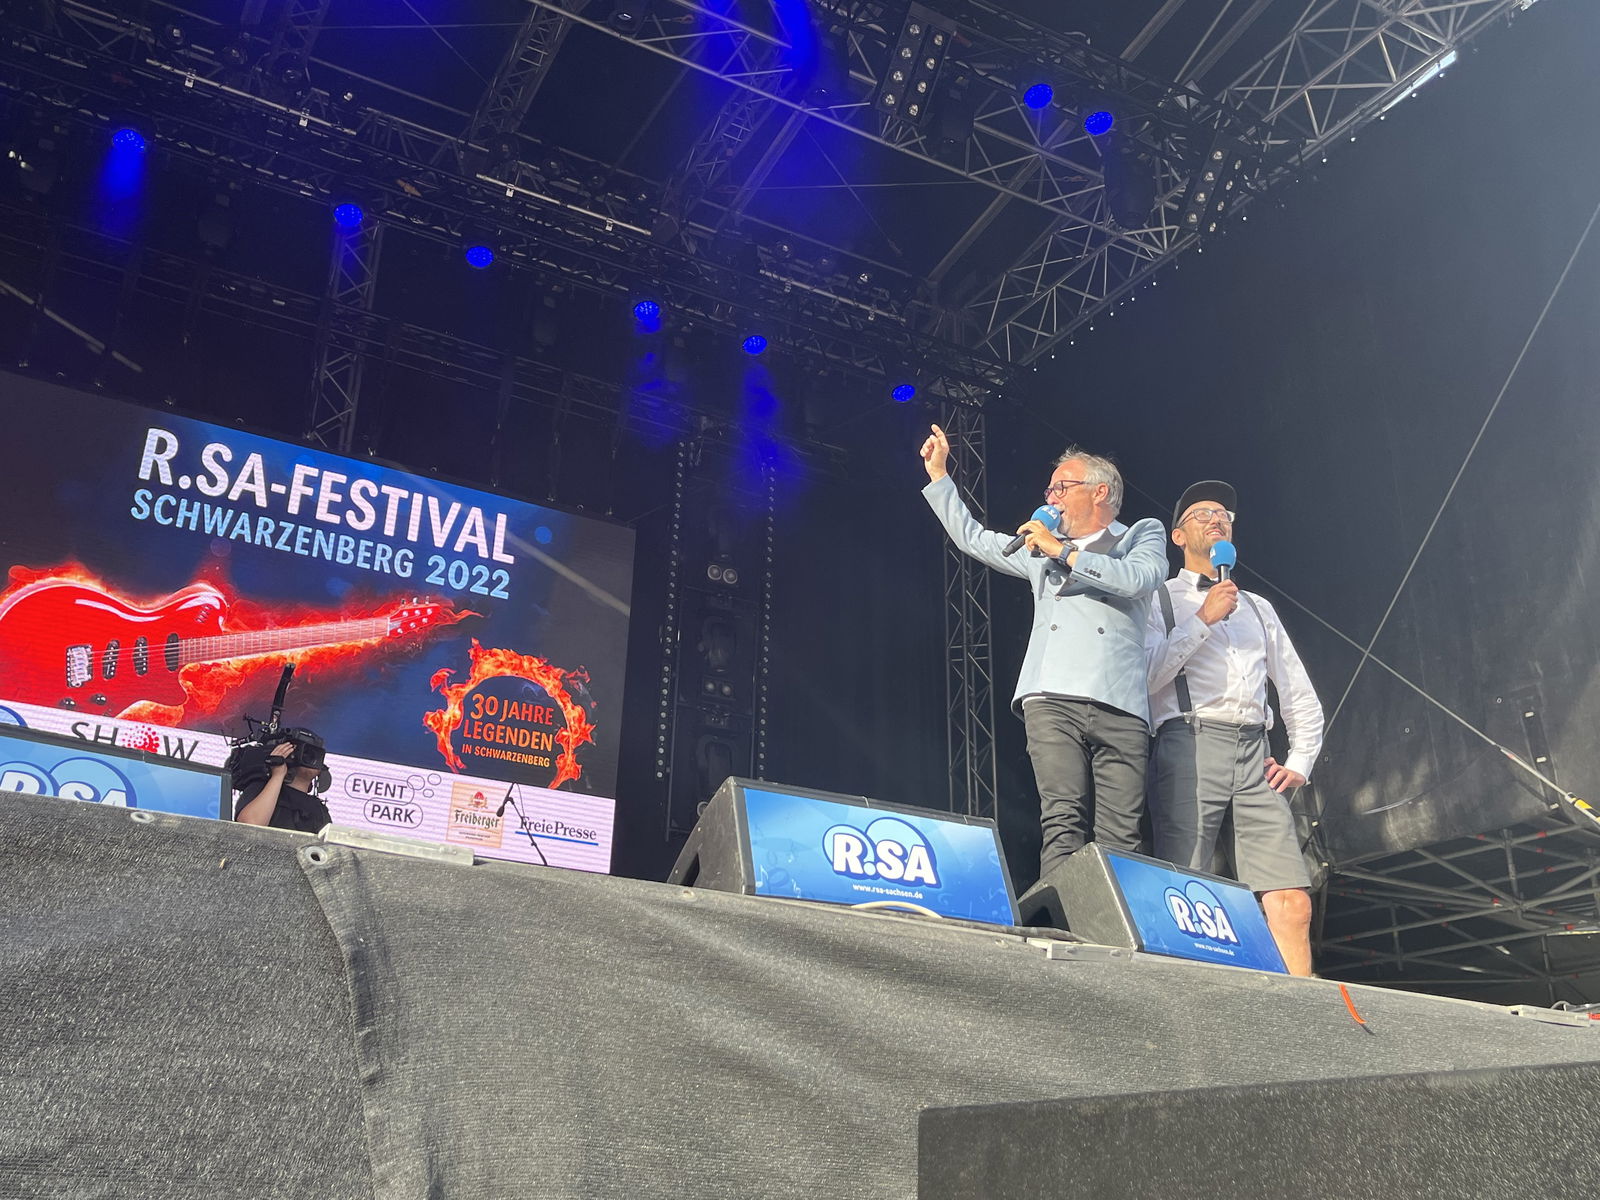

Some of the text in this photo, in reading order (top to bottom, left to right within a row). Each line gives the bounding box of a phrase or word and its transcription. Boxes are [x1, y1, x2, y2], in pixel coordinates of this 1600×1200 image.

[138, 427, 515, 564] R.SA-FESTIVAL
[130, 488, 511, 600] SCHWARZENBERG 2022
[470, 693, 554, 726] 30 JAHRE
[463, 719, 553, 752] LEGENDEN
[462, 743, 550, 768] IN SCHWARZENBERG
[352, 778, 408, 799] EVENT
[371, 803, 416, 824] PARK
[455, 809, 500, 829] Freiberger
[832, 832, 938, 886] R.SA
[852, 883, 924, 899] www.rsa-sachsen.de
[1169, 895, 1238, 943] R.SA
